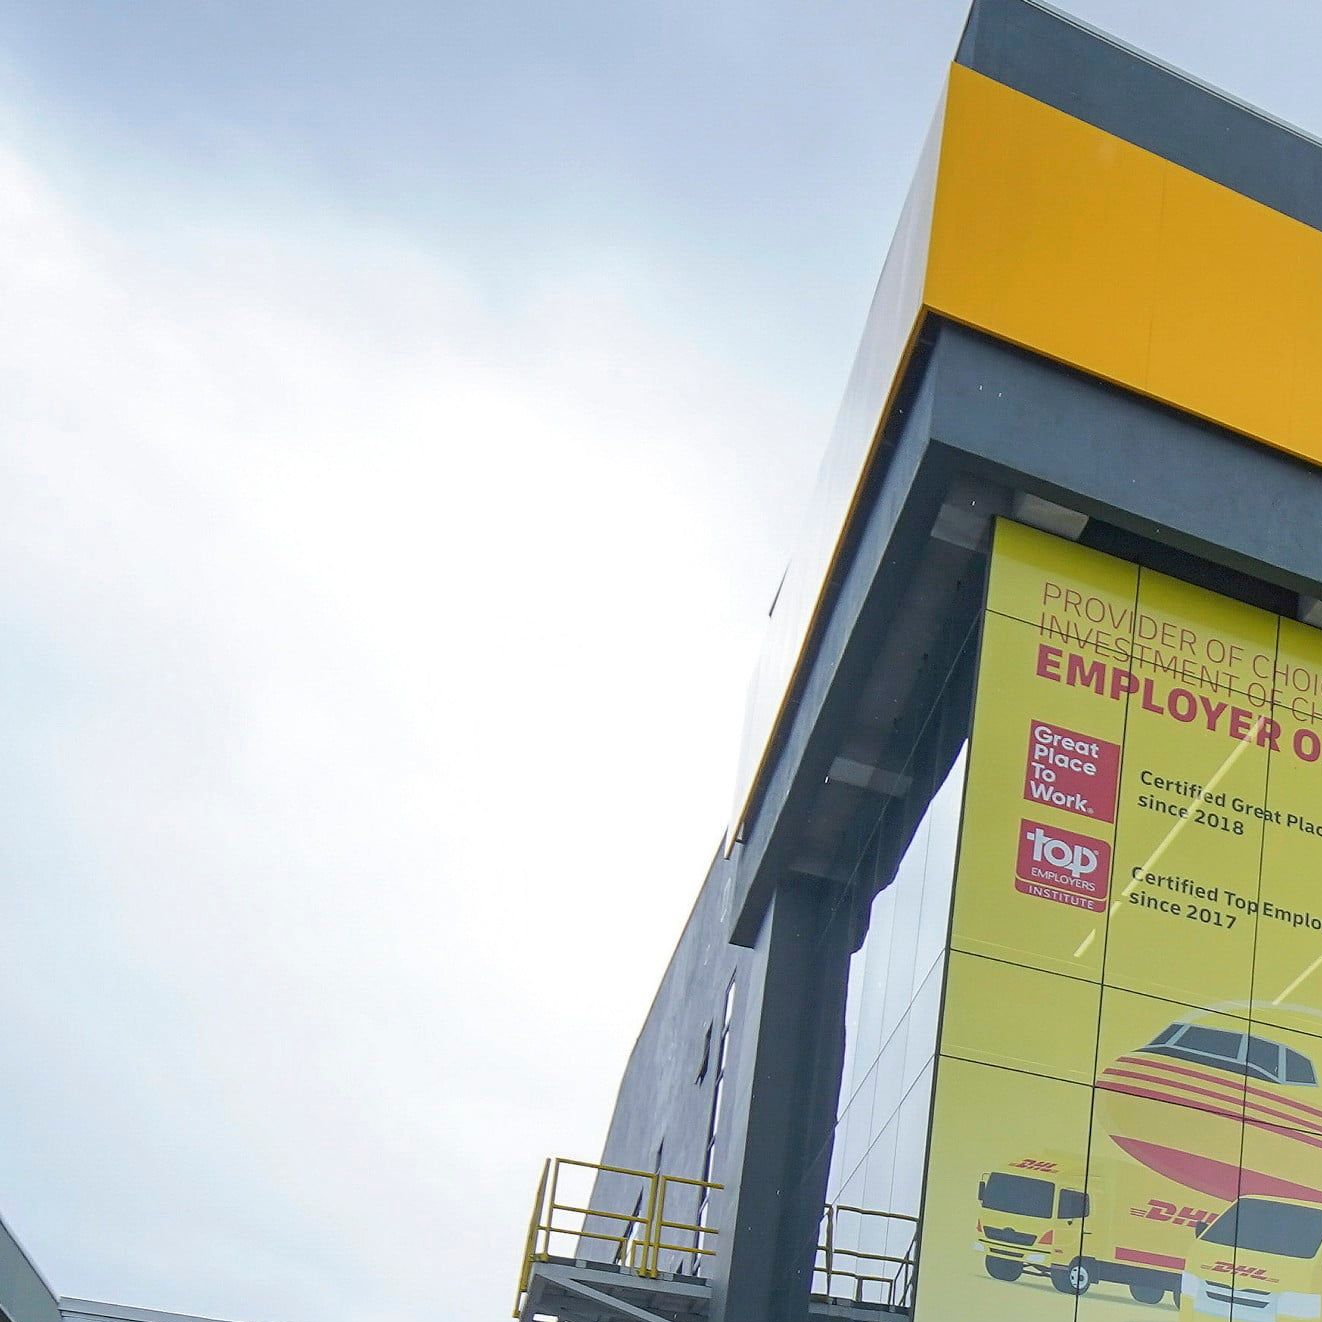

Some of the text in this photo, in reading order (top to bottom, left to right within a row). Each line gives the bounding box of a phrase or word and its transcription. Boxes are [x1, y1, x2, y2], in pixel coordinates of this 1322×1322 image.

[1043, 582, 1196, 655] PROVIDER
[1206, 638, 1244, 667] OF
[1040, 612, 1240, 697] INVESTMENT
[1247, 682, 1283, 708] OF
[1036, 643, 1281, 752] EMPLOYER
[1034, 726, 1099, 758] Great
[1034, 744, 1097, 776] Place
[1031, 762, 1056, 783] To
[1138, 794, 1244, 835] since 2018
[1140, 770, 1225, 807] Certified
[1232, 798, 1281, 825] Great
[1028, 885, 1095, 910] INSTITUTE
[1031, 867, 1096, 891] EMPLOYERS
[1131, 866, 1217, 903] Certified
[1224, 890, 1260, 916] Top
[1129, 890, 1236, 930] since 2017
[1211, 1261, 1269, 1281] DHL
